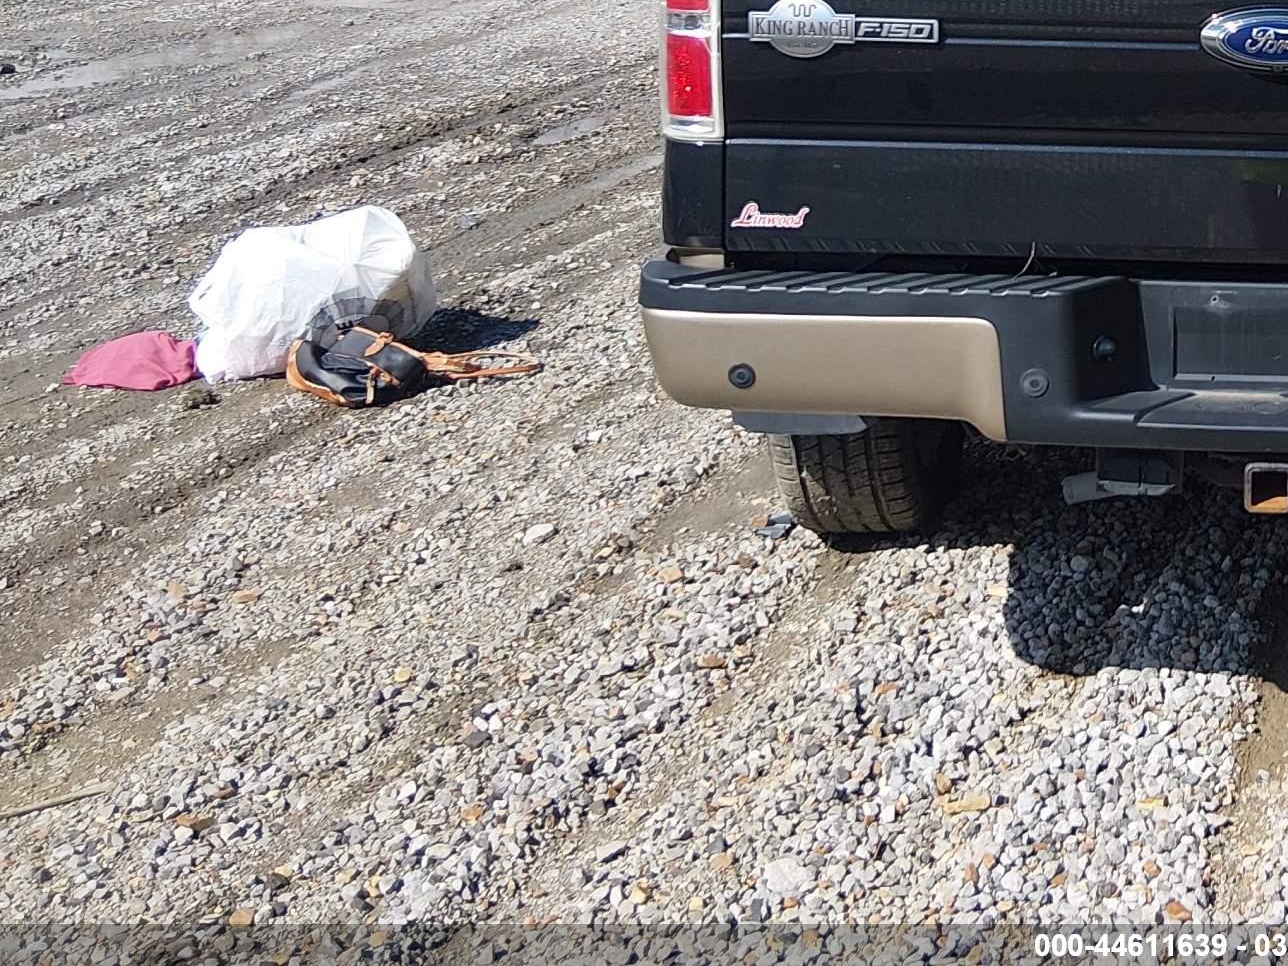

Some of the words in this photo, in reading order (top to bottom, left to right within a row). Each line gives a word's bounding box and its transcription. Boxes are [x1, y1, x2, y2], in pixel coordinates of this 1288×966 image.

[755, 18, 793, 35] KING
[798, 19, 850, 36] RANCH
[857, 22, 931, 38] F-150
[731, 202, 810, 227] Linwood
